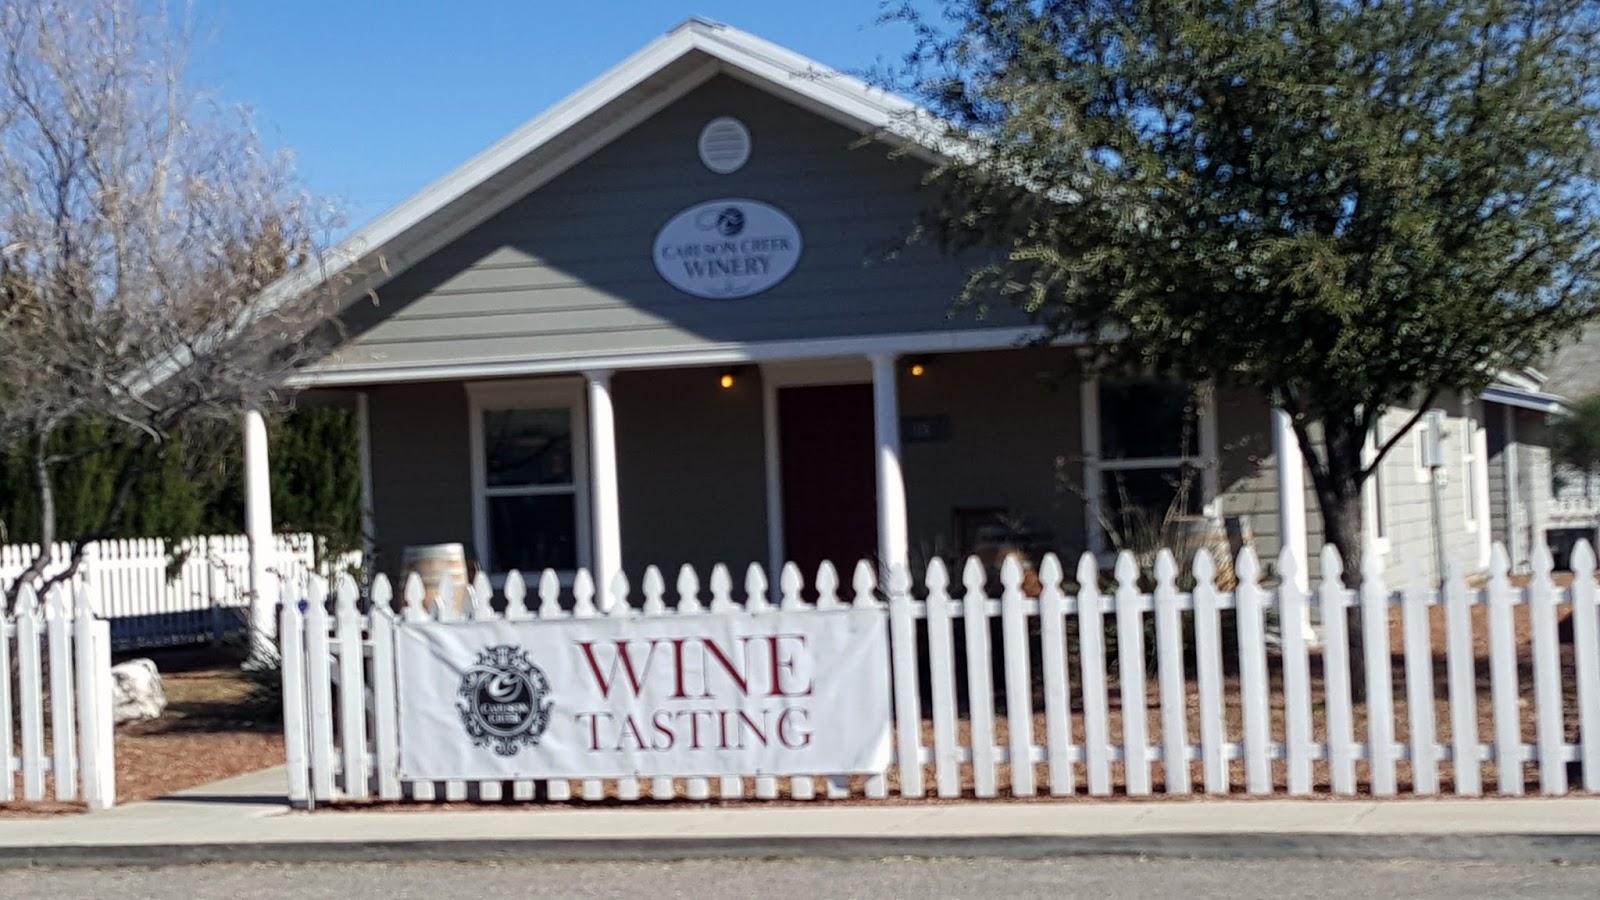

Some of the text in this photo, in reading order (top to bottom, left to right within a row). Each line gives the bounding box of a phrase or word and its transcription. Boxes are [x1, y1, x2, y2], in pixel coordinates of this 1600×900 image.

[741, 238, 791, 253] CREEK
[683, 257, 769, 278] WINERY
[574, 634, 814, 699] WINE
[575, 707, 814, 752] TASTING
